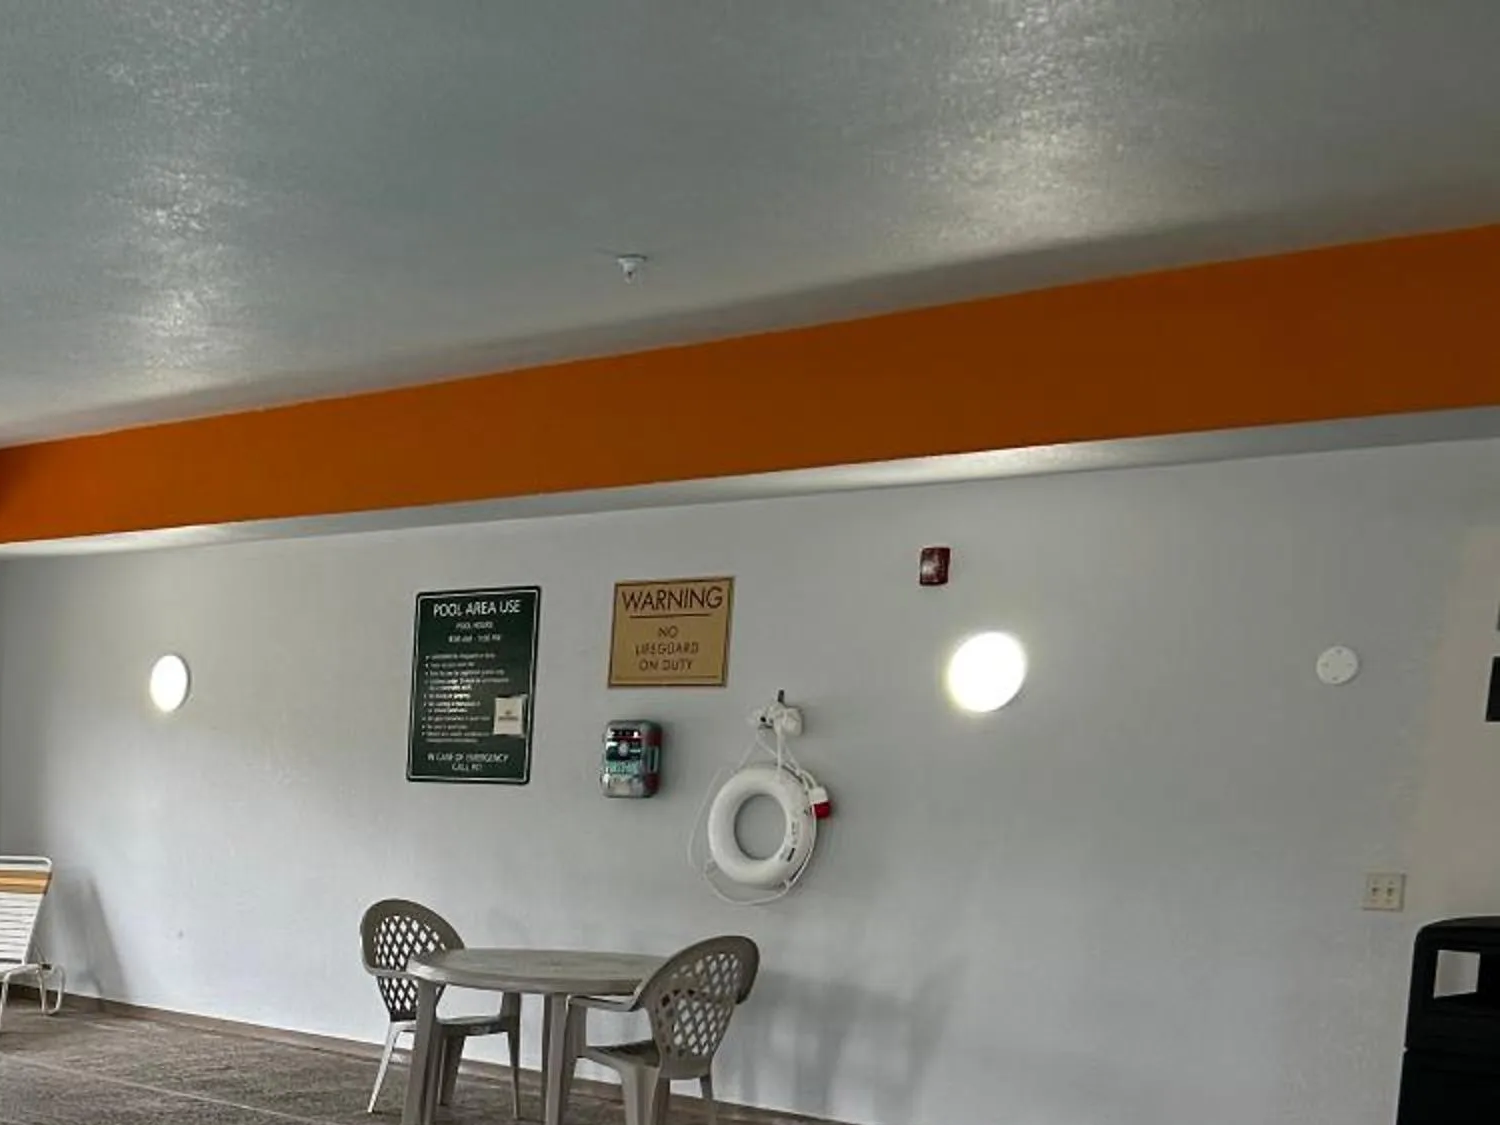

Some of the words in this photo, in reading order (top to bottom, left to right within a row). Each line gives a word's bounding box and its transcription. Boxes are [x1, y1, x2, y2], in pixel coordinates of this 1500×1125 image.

[622, 586, 723, 612] WARNING
[434, 603, 463, 617] POOL
[465, 602, 496, 615] AREA
[499, 599, 521, 613] USE
[658, 625, 679, 638] NO
[635, 642, 699, 656] LIFEGUARD
[639, 659, 659, 672] ON
[662, 659, 693, 672] DUTY
